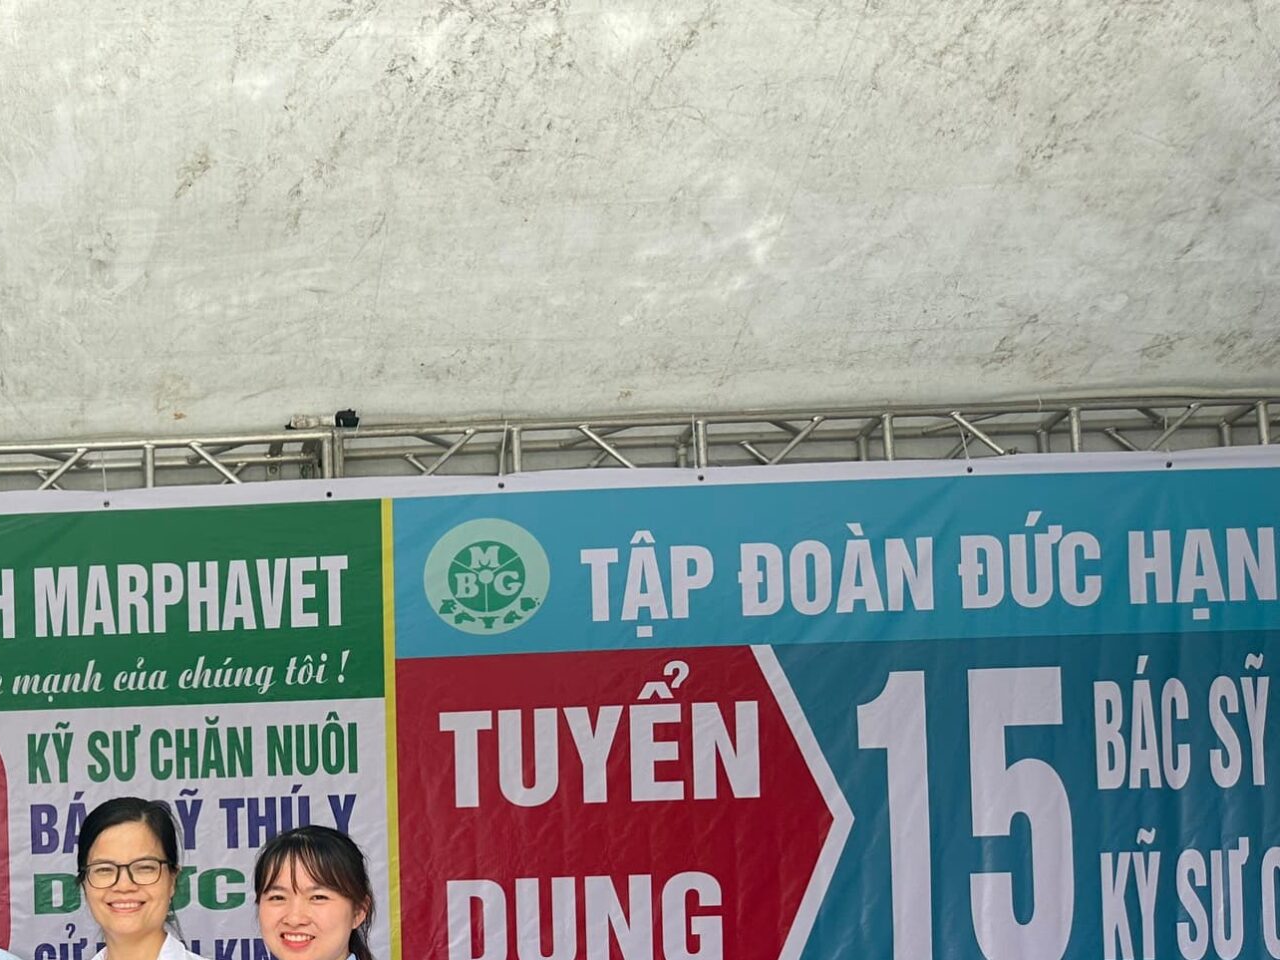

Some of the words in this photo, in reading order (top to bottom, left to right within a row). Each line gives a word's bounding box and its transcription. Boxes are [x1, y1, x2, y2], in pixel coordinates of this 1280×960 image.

[34, 554, 349, 638] MARPHAVET
[580, 529, 714, 638] TẬP
[738, 522, 935, 617] ĐOÀN
[958, 510, 1103, 608] ĐỨC
[13, 658, 105, 702] mạnh
[112, 656, 169, 691] của
[178, 654, 278, 694] chúng
[284, 652, 329, 685] tôi
[1093, 655, 1191, 790] BÁC
[1208, 651, 1270, 789] SỸ
[27, 722, 73, 785] KỸ
[87, 723, 138, 783] SƯ
[149, 716, 254, 780] CHĂN
[266, 711, 359, 776] NUÔI
[438, 659, 761, 808] TUYỂN
